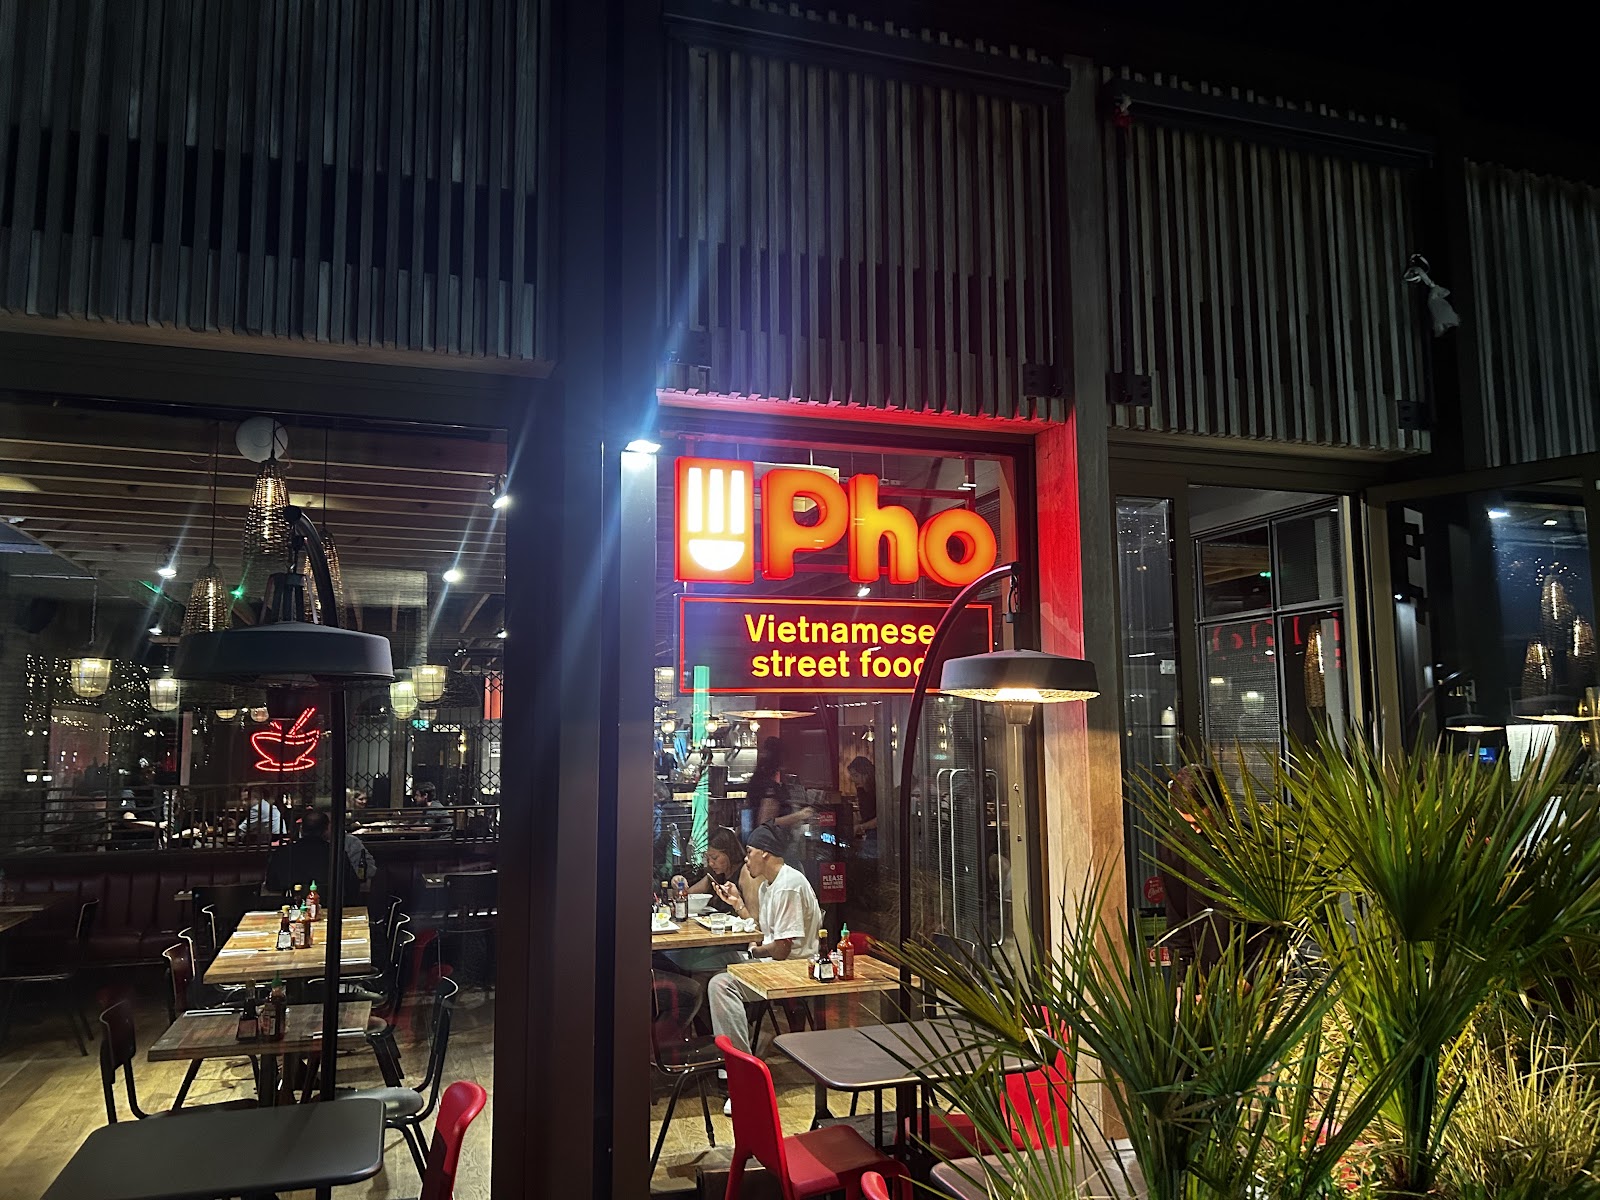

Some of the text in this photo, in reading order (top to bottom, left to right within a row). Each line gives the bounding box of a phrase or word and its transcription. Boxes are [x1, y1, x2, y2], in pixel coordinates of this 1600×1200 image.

[760, 468, 997, 587] Pho
[744, 614, 935, 645] Vietnamese
[751, 649, 850, 678] street
